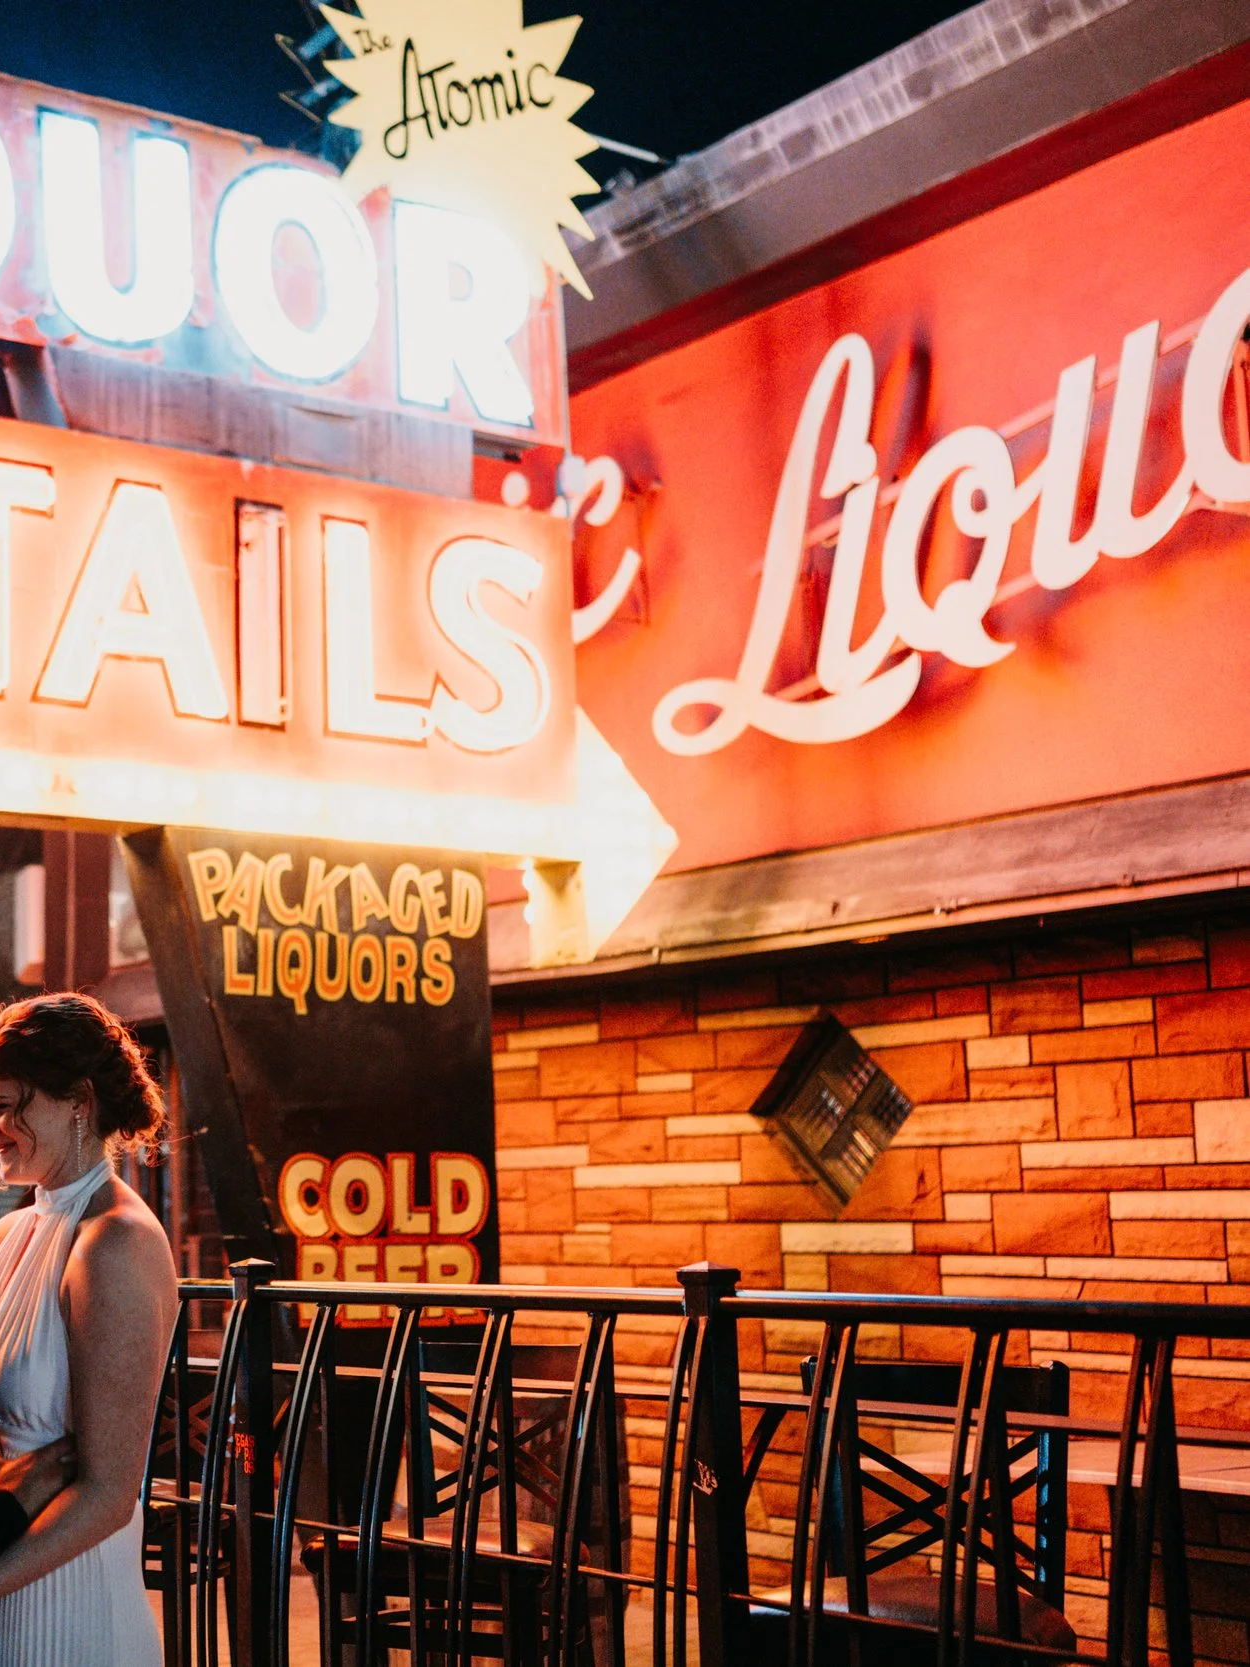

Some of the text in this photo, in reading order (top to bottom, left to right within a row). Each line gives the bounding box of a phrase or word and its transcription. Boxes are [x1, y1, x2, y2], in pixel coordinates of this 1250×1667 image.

[353, 28, 395, 55] The
[383, 37, 555, 160] Atomic
[187, 846, 484, 939] PACKAGED
[222, 924, 456, 1016] LIQUORS
[278, 1152, 490, 1239] COLD
[296, 1235, 487, 1328] BEER
